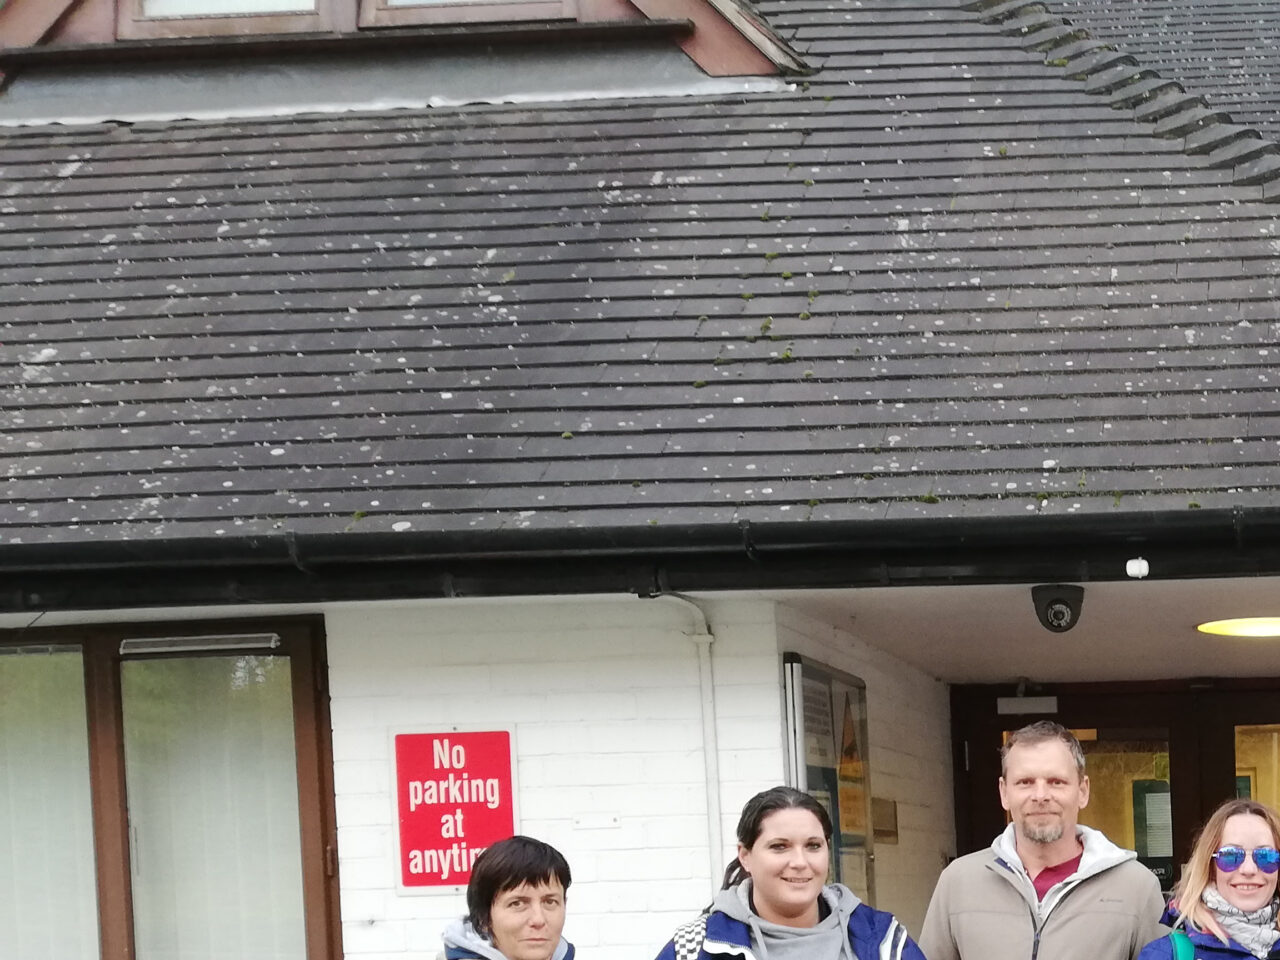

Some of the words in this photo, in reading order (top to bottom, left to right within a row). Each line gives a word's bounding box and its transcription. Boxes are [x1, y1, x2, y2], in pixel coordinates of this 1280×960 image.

[433, 738, 466, 769] No
[408, 772, 500, 812] parking
[440, 808, 465, 839] at
[408, 842, 488, 880] anyti
